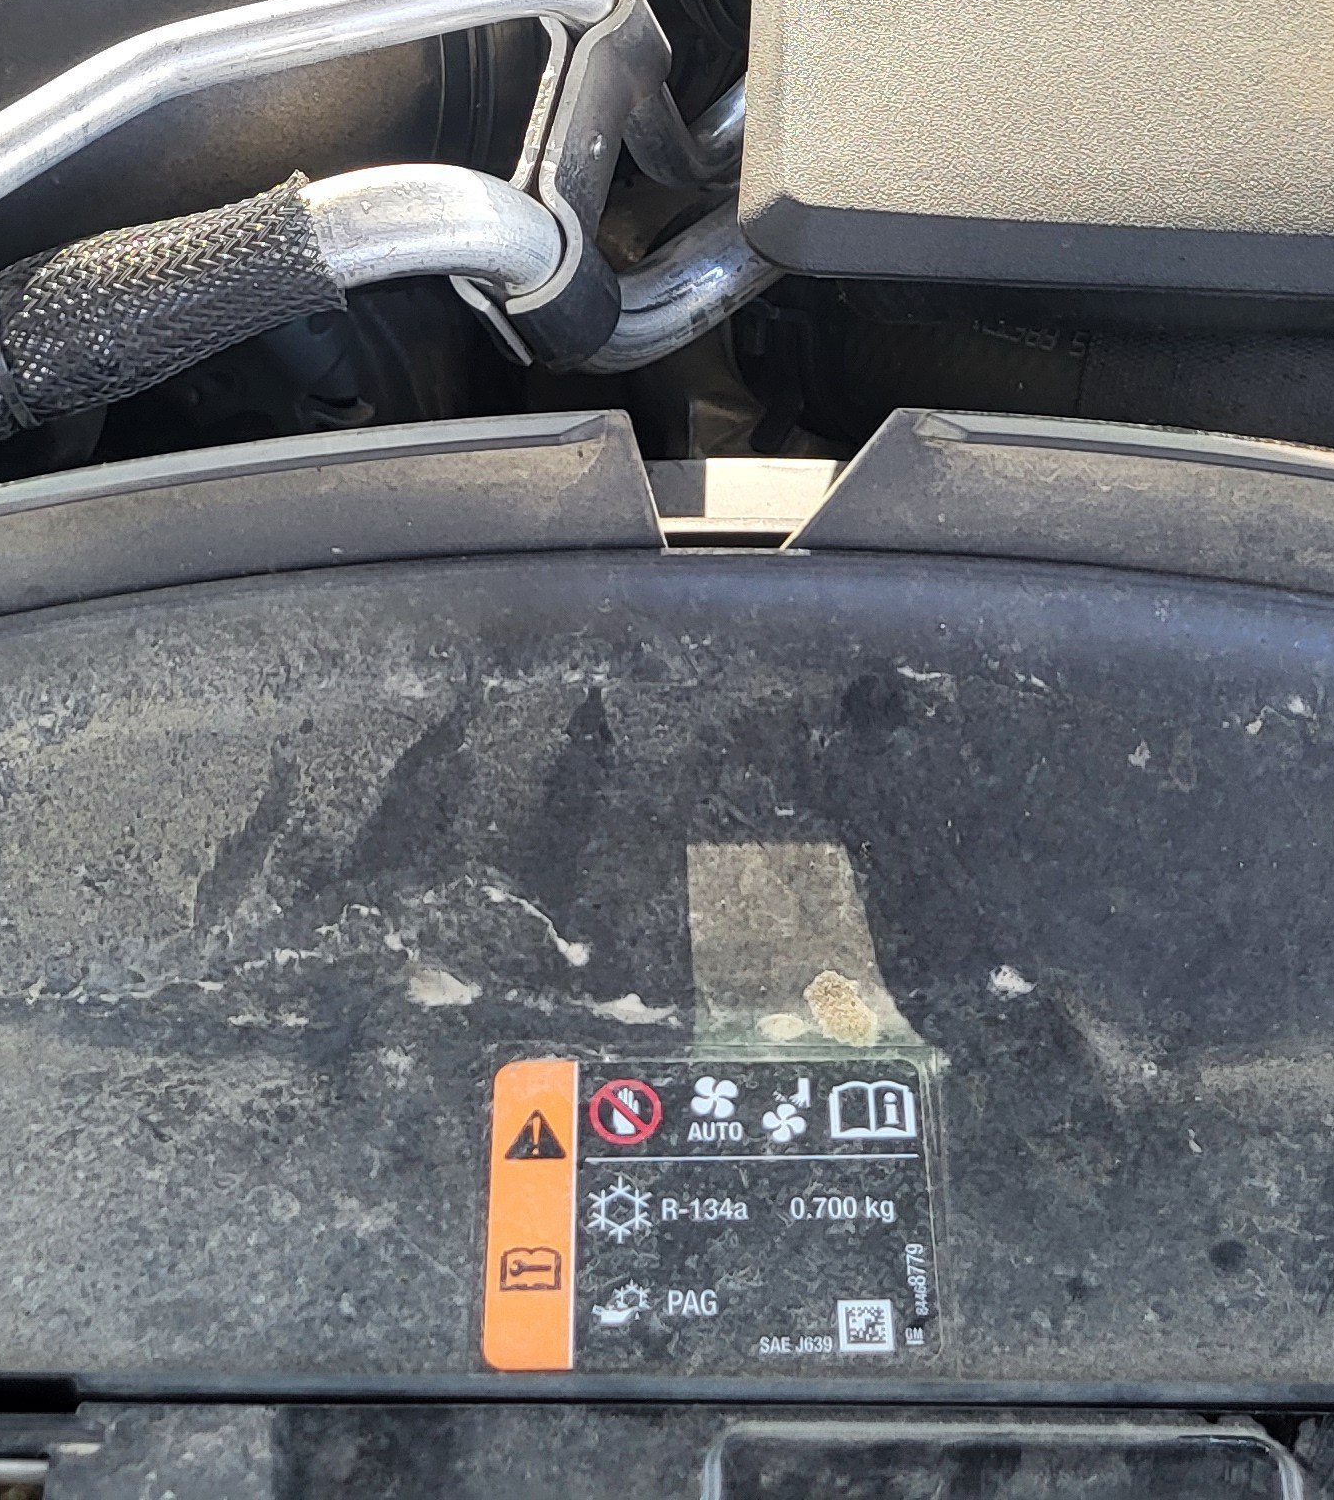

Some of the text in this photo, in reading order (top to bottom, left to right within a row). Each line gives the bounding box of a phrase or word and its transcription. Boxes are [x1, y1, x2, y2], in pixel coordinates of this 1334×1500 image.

[687, 1121, 744, 1142] AUTO
[661, 1195, 896, 1224] R-134a 0.700 kg
[667, 1288, 718, 1317] PAG
[758, 1335, 834, 1354] SAE J639
[904, 1326, 925, 1345] GM
